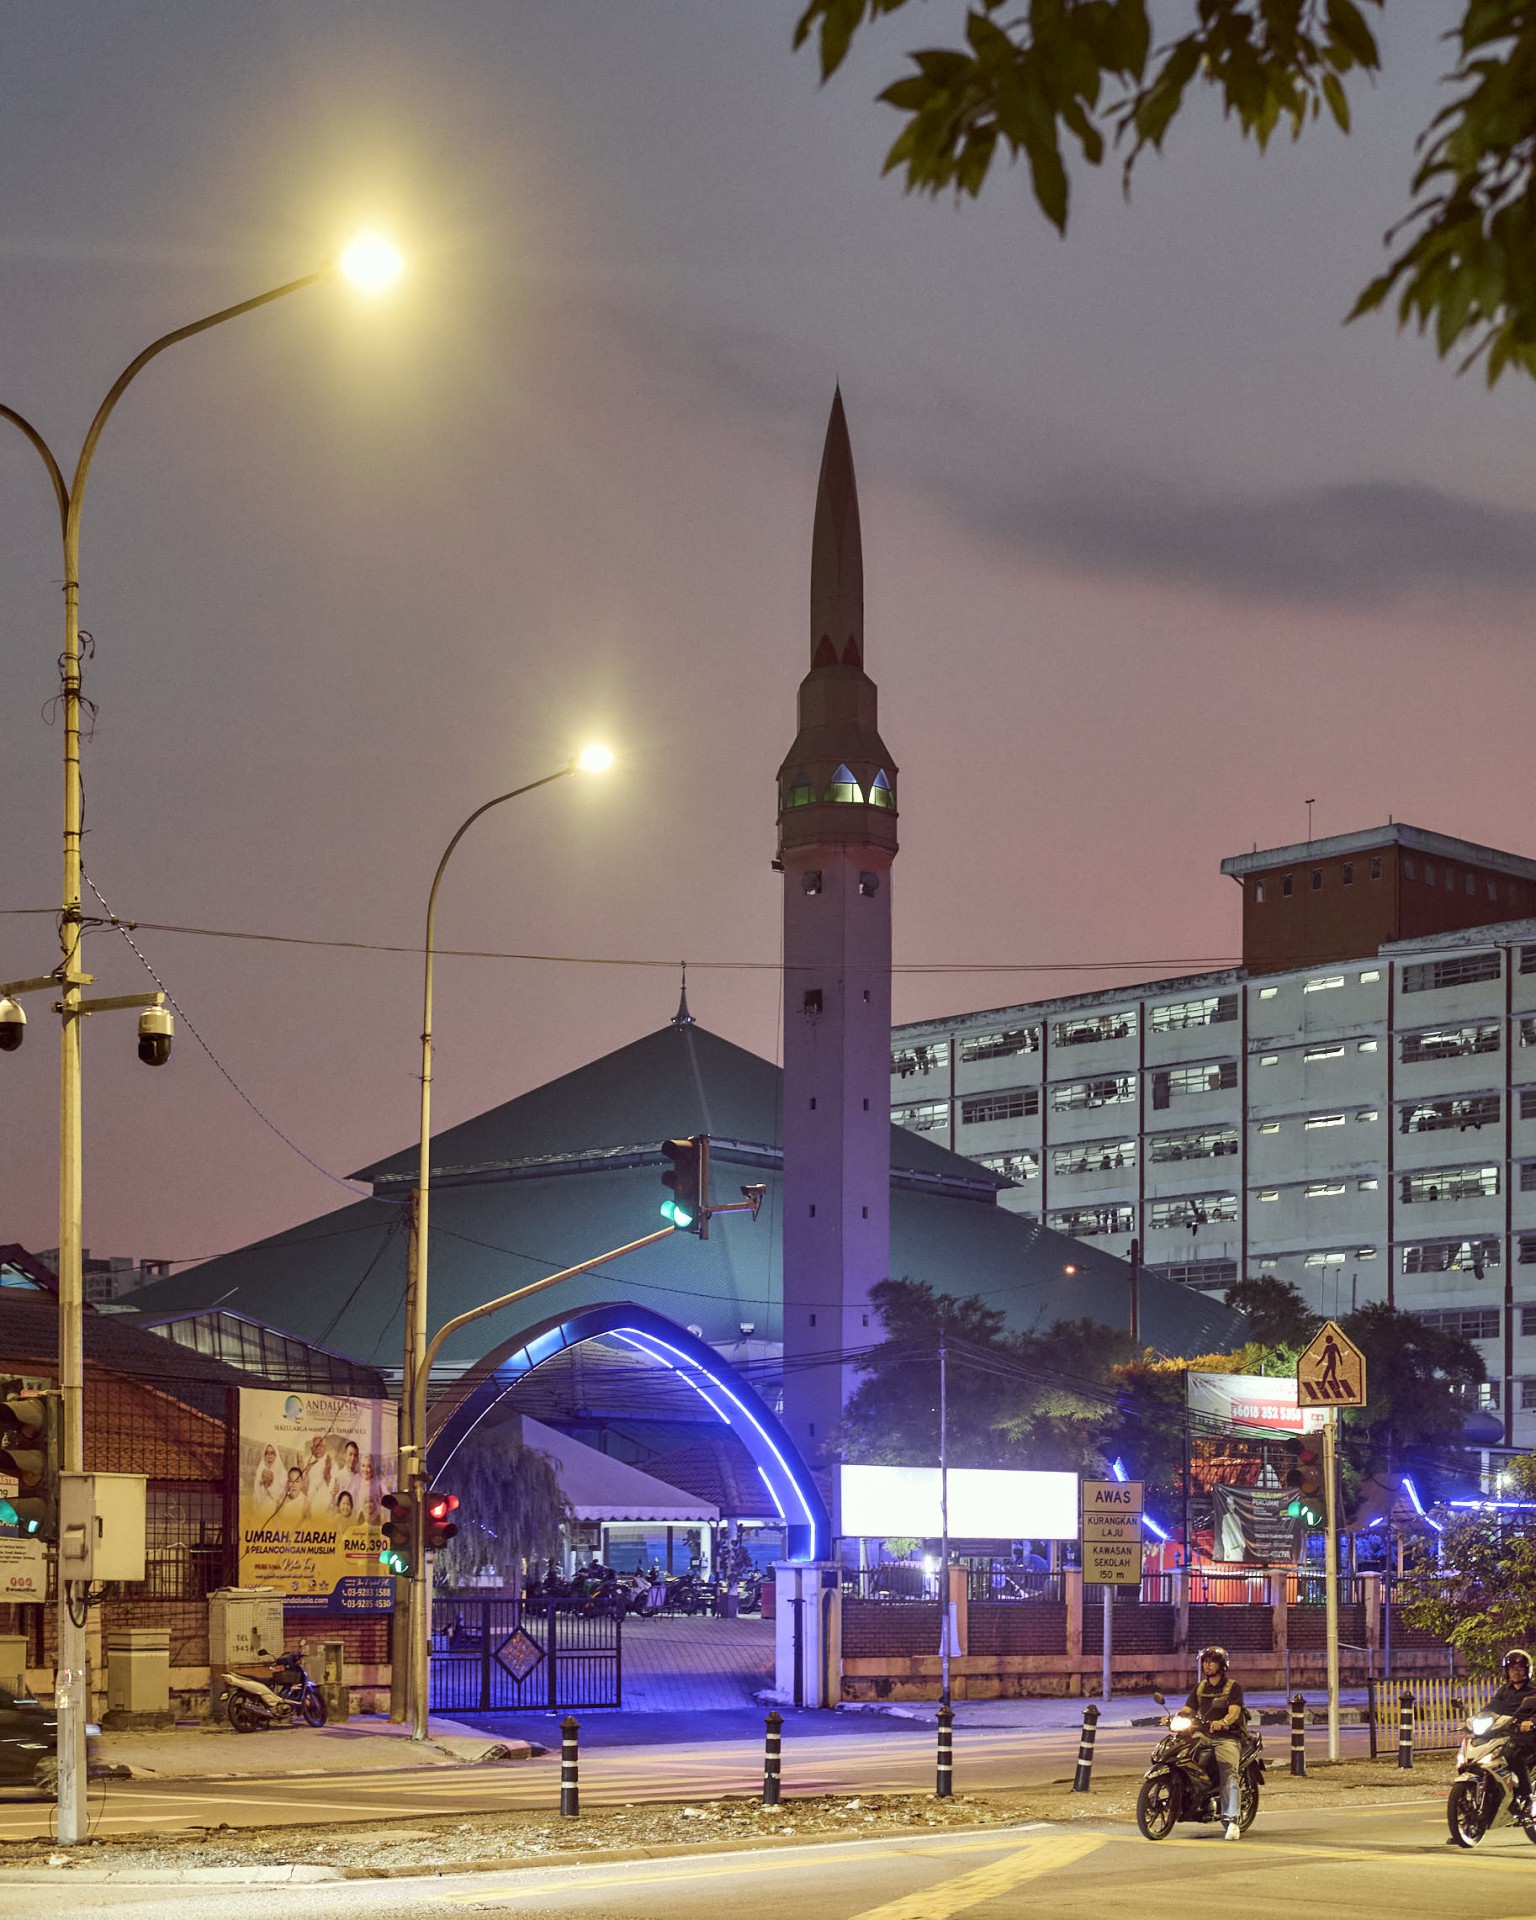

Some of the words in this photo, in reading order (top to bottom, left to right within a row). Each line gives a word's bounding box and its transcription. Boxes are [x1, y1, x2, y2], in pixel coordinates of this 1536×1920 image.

[306, 1399, 359, 1412] ANDALUSIA
[1094, 1490, 1131, 1504] AWAS
[1087, 1516, 1138, 1526] KURANGKAN
[244, 1530, 292, 1545] UMRAH,
[294, 1530, 337, 1544] ZIARAH
[1101, 1529, 1123, 1537] LAJU
[251, 1545, 306, 1554] PELANCONGAN
[306, 1546, 336, 1555] MUSLIM
[344, 1539, 388, 1552] RM6,390
[1092, 1546, 1133, 1555] KAWASAN
[1094, 1558, 1131, 1567] SEKOLAH
[1100, 1570, 1113, 1579] 150
[347, 1587, 374, 1597] 03-9283
[375, 1588, 391, 1597] 1588
